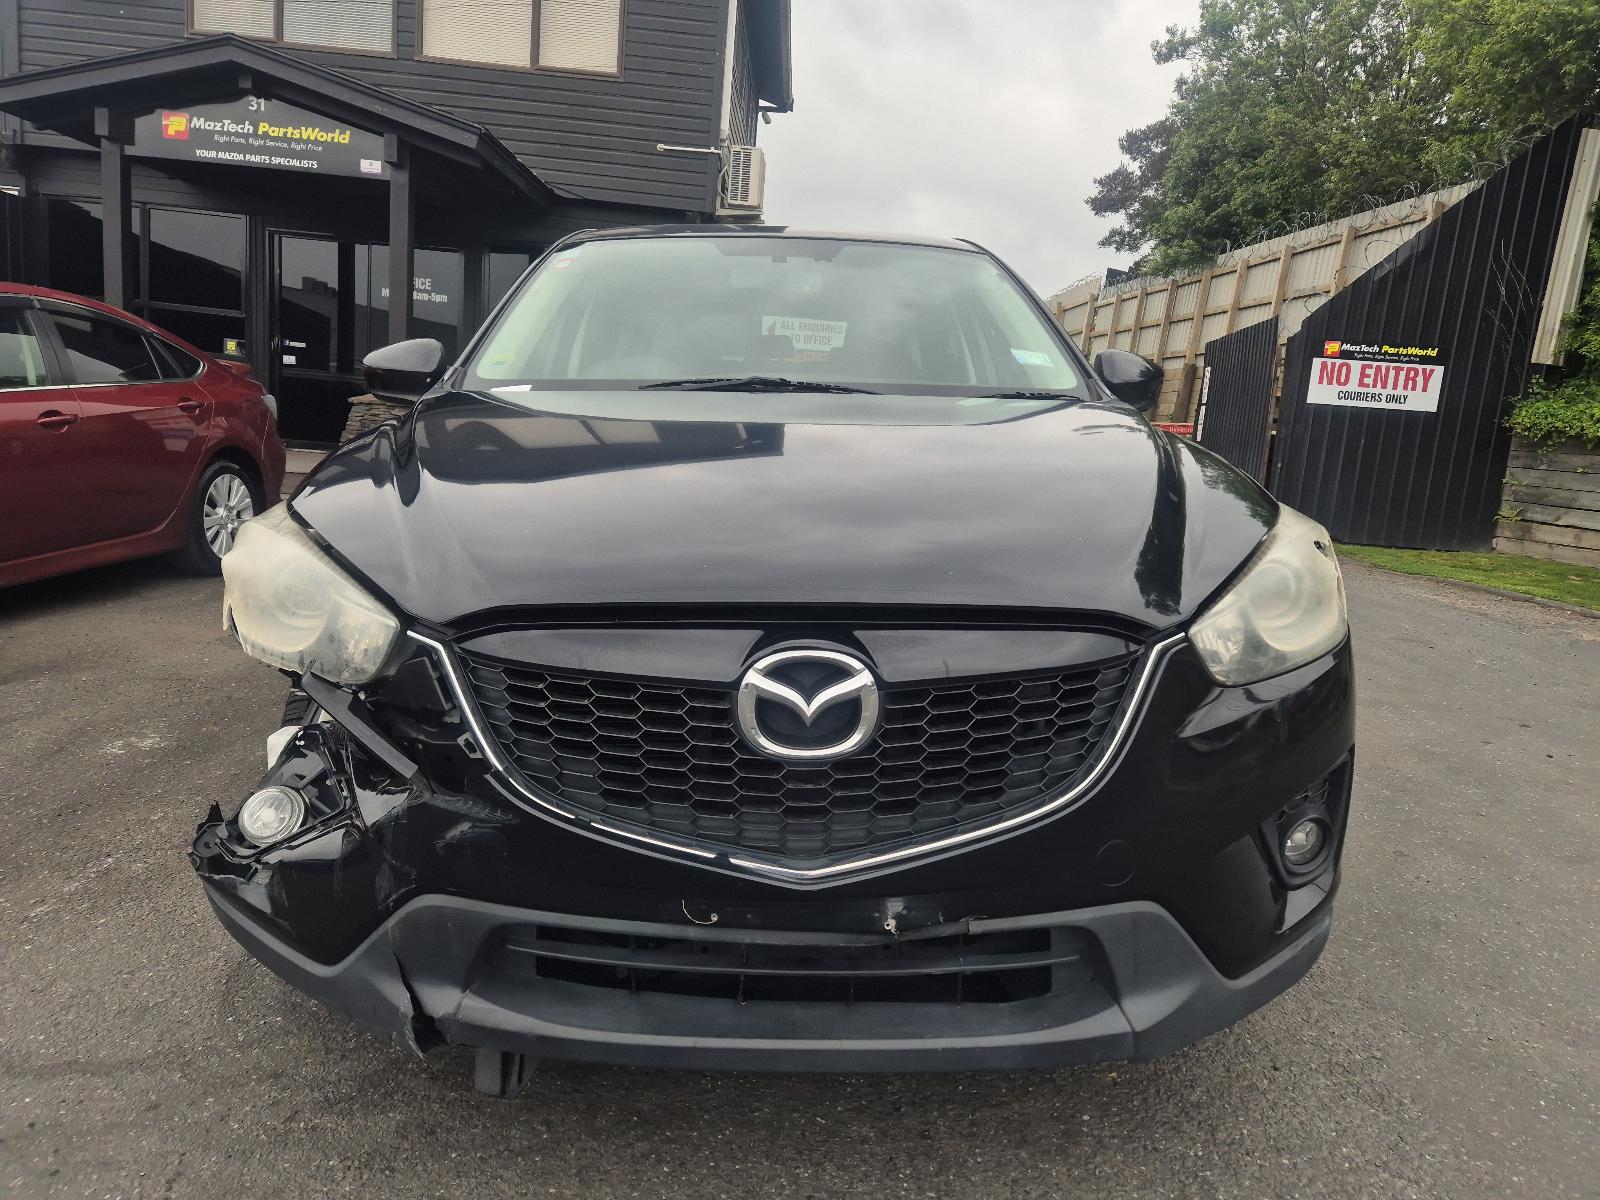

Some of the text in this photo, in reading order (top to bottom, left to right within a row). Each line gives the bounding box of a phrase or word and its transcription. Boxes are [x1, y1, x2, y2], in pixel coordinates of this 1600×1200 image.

[248, 96, 265, 111] 31
[190, 116, 254, 134] MazTech
[258, 121, 351, 144] PartsWorld
[214, 134, 323, 152] Right Parts, Right Service, Right Price
[195, 149, 318, 169] YOUR MAZDA PARTS SPECIALISTS
[413, 277, 432, 291] ICE
[780, 320, 844, 335] ALL ENQUIRIES
[803, 335, 832, 346] OFFICE
[1341, 343, 1380, 353] MazTech
[1381, 345, 1439, 357] PartsWorld
[1318, 360, 1436, 393] NO ENTRY
[1337, 390, 1409, 405] COURIERS ONLY
